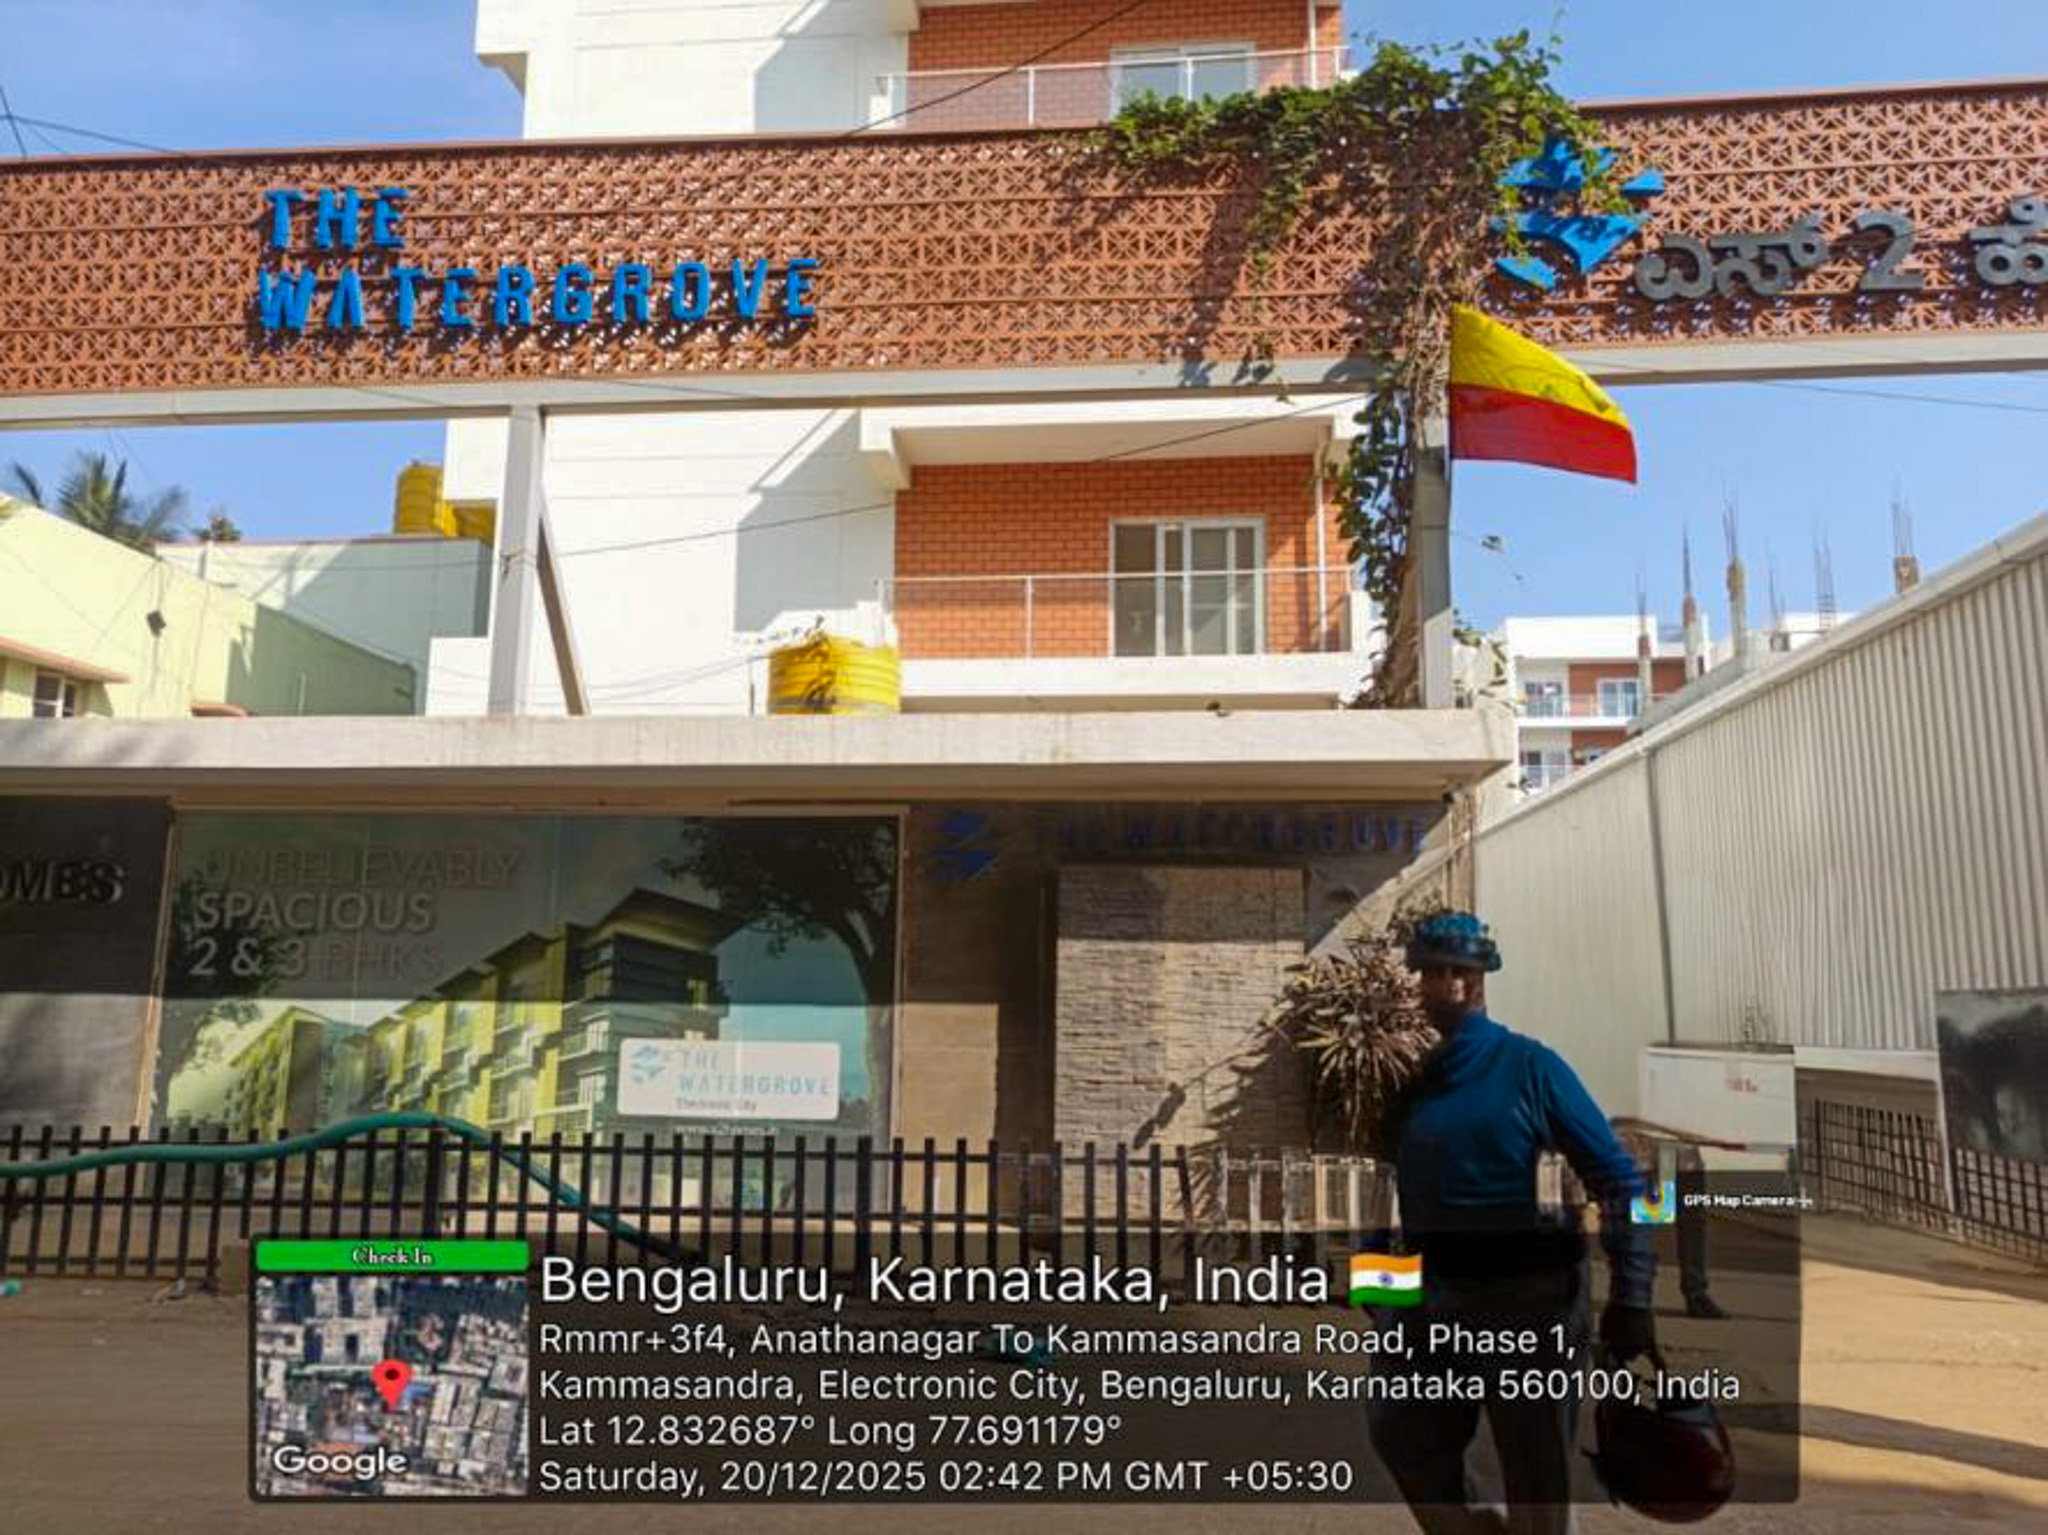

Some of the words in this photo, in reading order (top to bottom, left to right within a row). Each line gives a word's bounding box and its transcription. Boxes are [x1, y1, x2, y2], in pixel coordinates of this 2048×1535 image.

[265, 186, 408, 249] THE
[1852, 210, 1923, 290] 2
[258, 257, 819, 330] WATERGROVE
[196, 892, 434, 931] SPACIOUS
[188, 938, 218, 976] 2
[230, 938, 264, 977] &
[284, 938, 308, 977] 3
